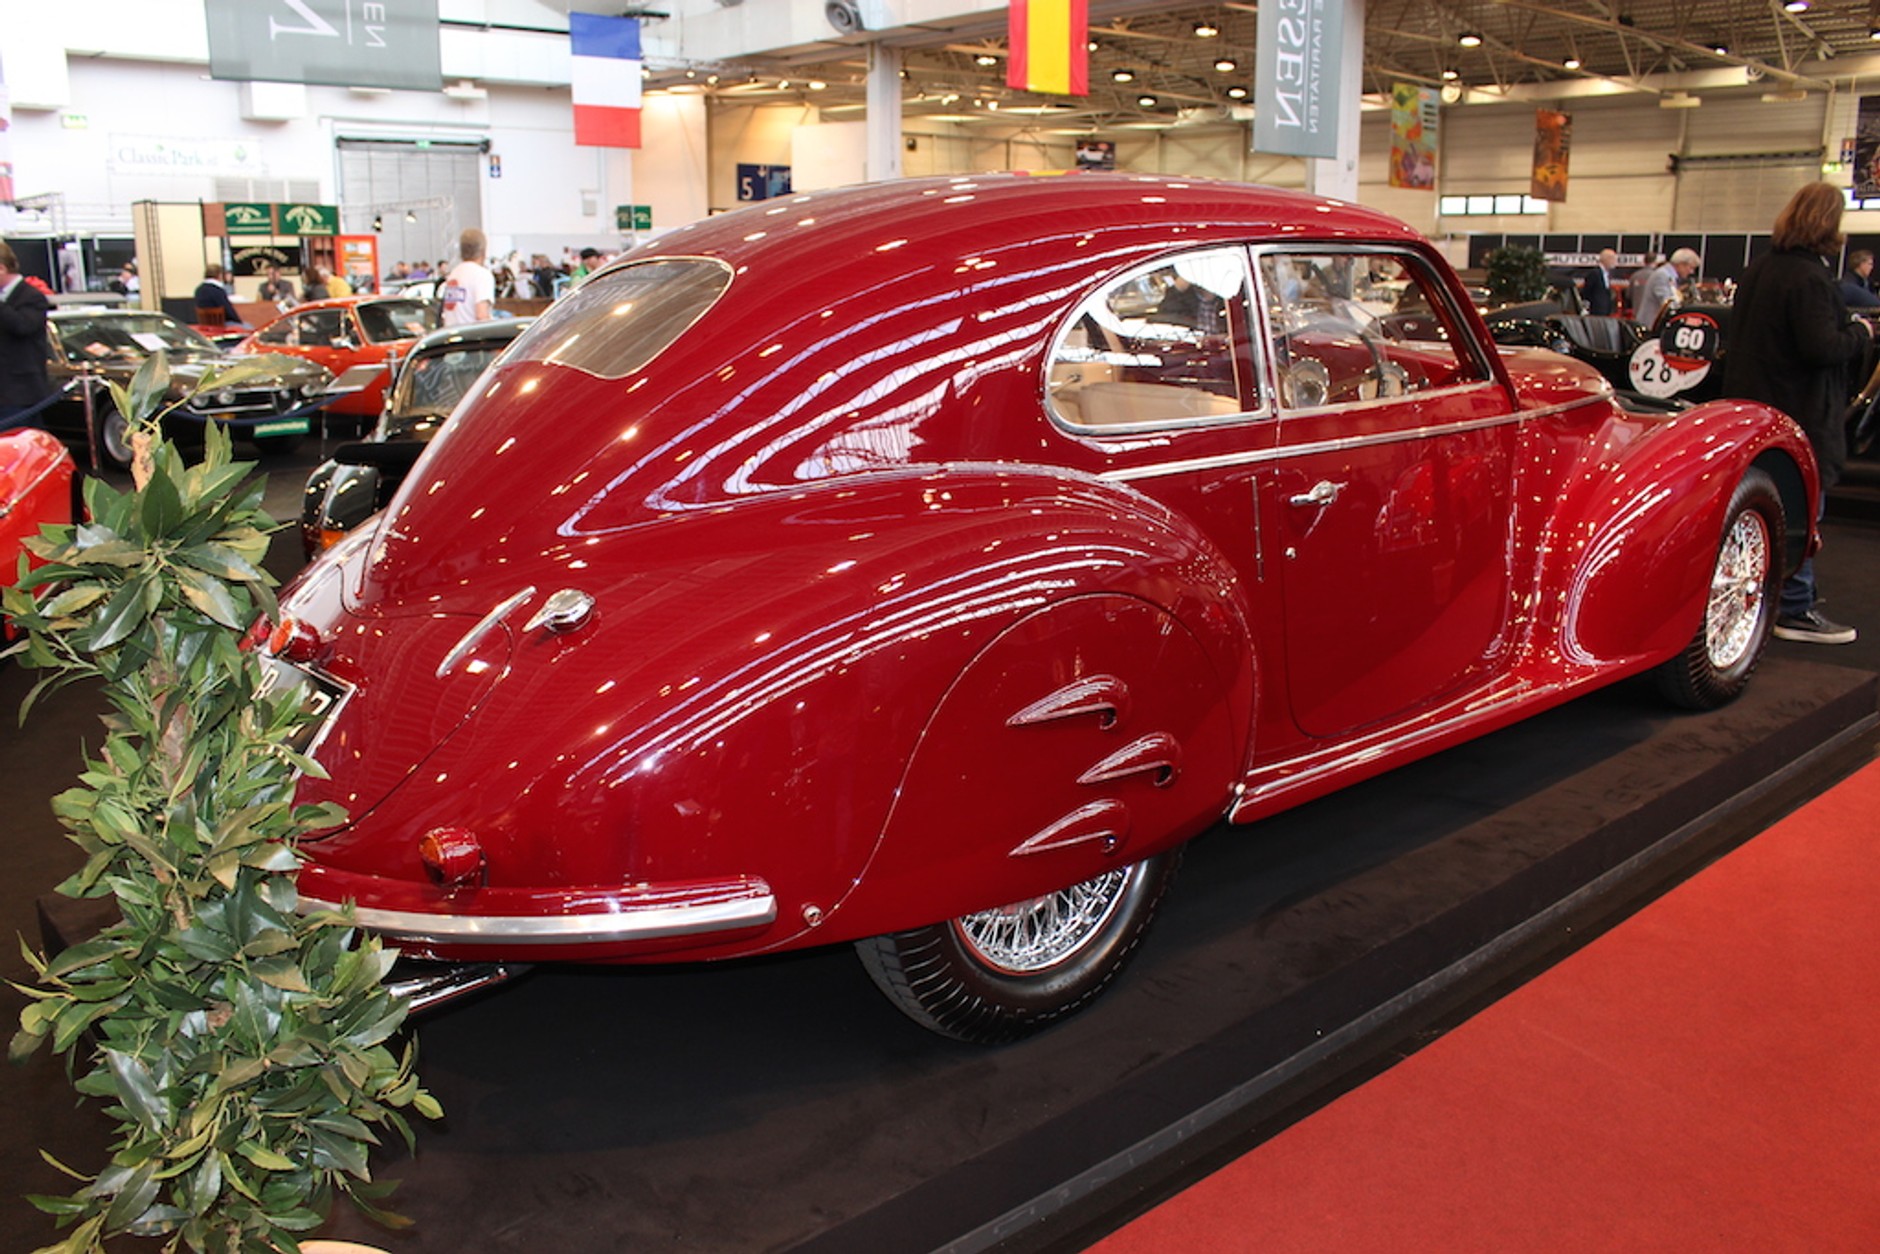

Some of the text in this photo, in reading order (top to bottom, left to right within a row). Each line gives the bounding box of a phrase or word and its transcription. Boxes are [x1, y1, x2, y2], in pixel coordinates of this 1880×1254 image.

[742, 176, 754, 200] 5
[1674, 326, 1705, 351] 60
[1642, 358, 1672, 384] 28
